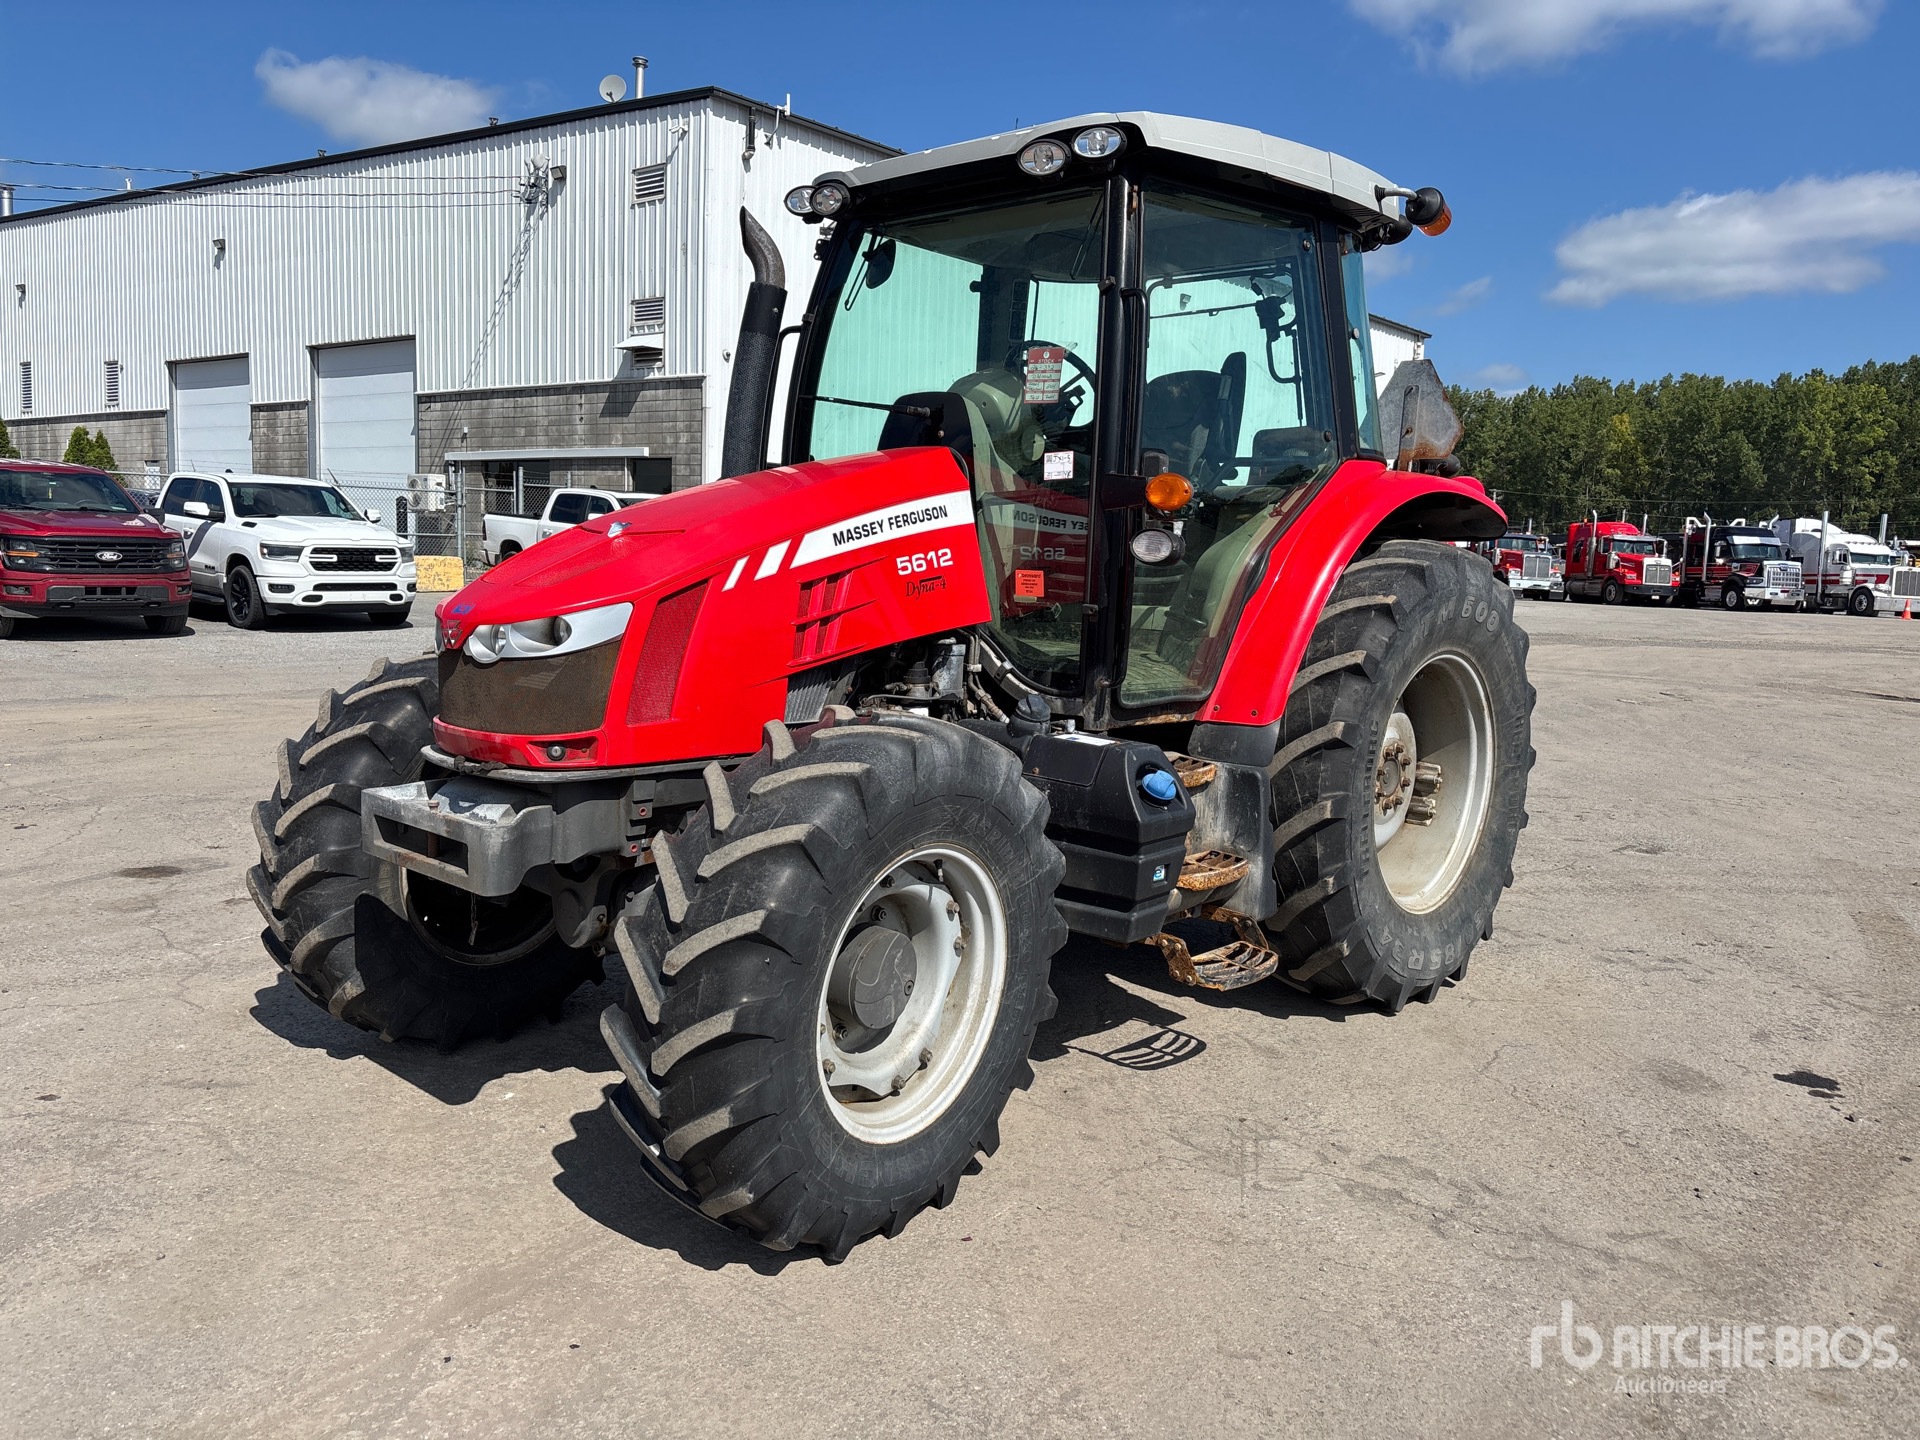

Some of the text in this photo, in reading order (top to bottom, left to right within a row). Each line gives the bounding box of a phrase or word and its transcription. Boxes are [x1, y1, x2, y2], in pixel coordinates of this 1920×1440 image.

[833, 505, 948, 546] MASSEY FERGUSON
[896, 548, 953, 576] 5612
[906, 576, 947, 599] Dyna-4
